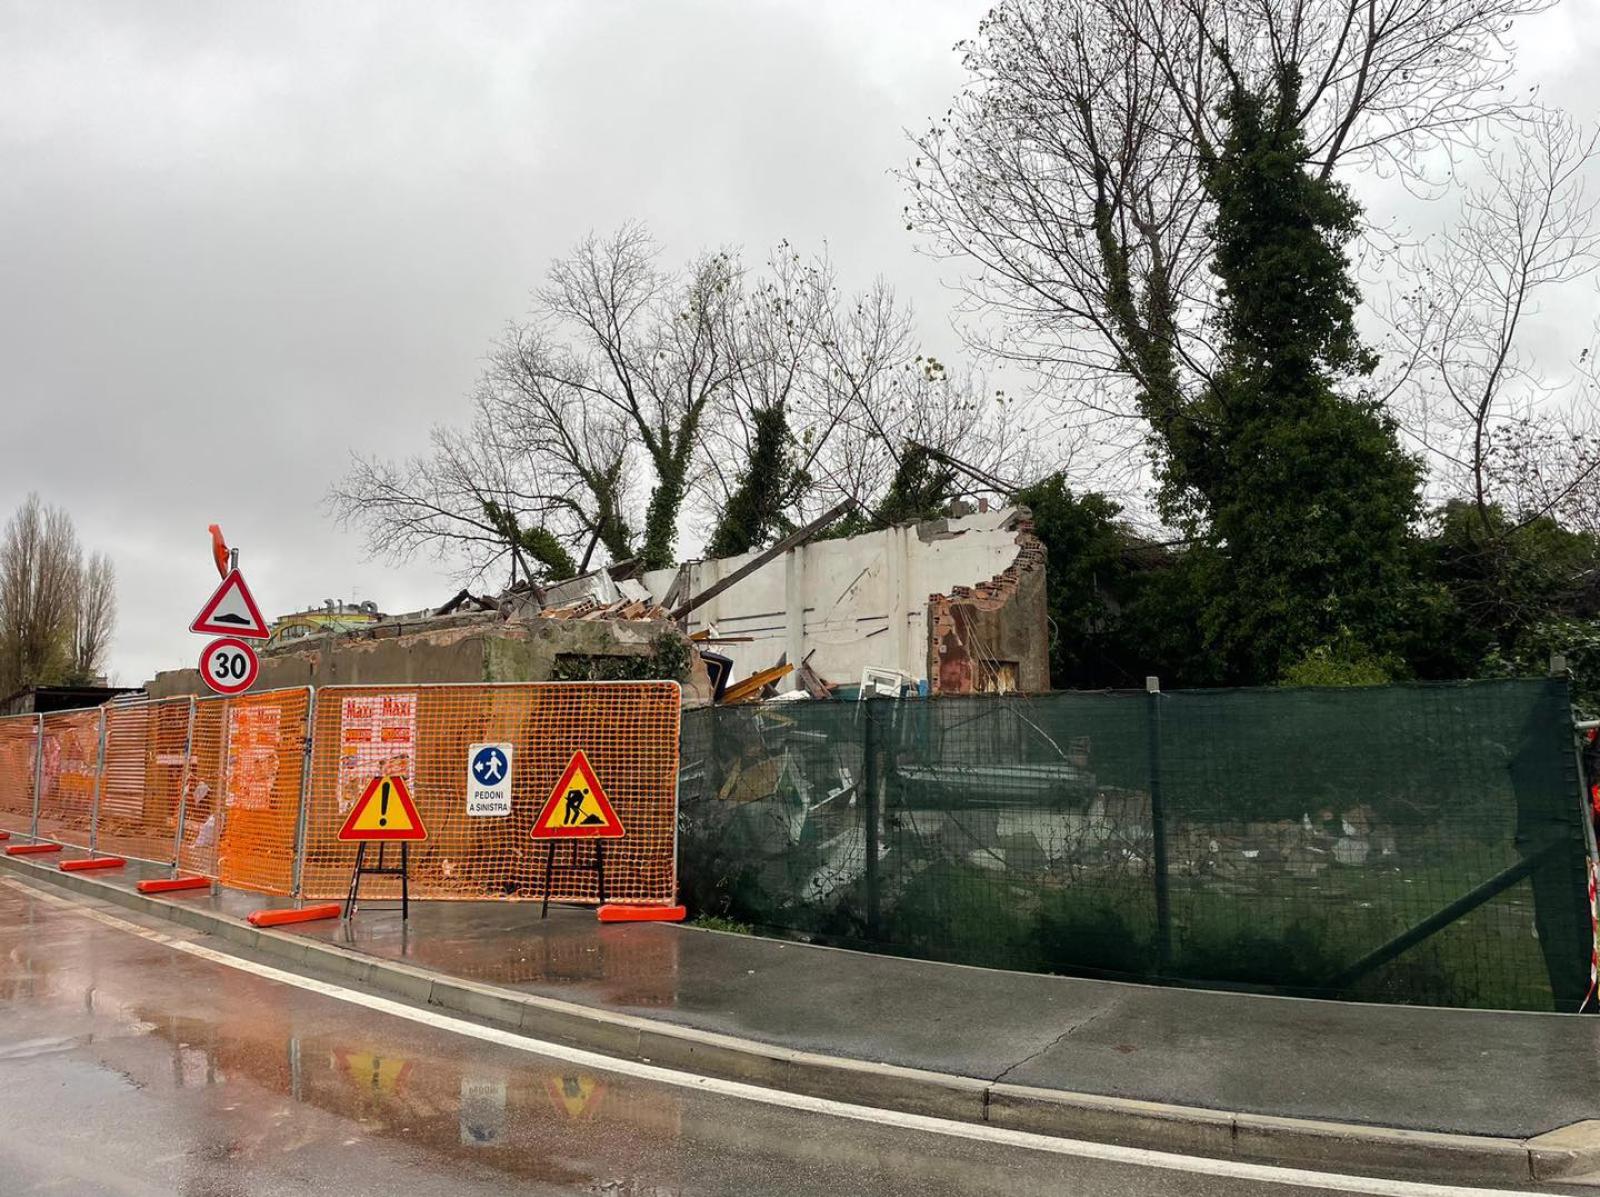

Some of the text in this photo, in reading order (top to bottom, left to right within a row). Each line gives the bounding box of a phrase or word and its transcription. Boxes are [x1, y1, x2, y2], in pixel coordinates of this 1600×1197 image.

[215, 652, 246, 679] 30
[475, 791, 504, 800] PEDONI
[469, 803, 508, 812] A SINISTRA
